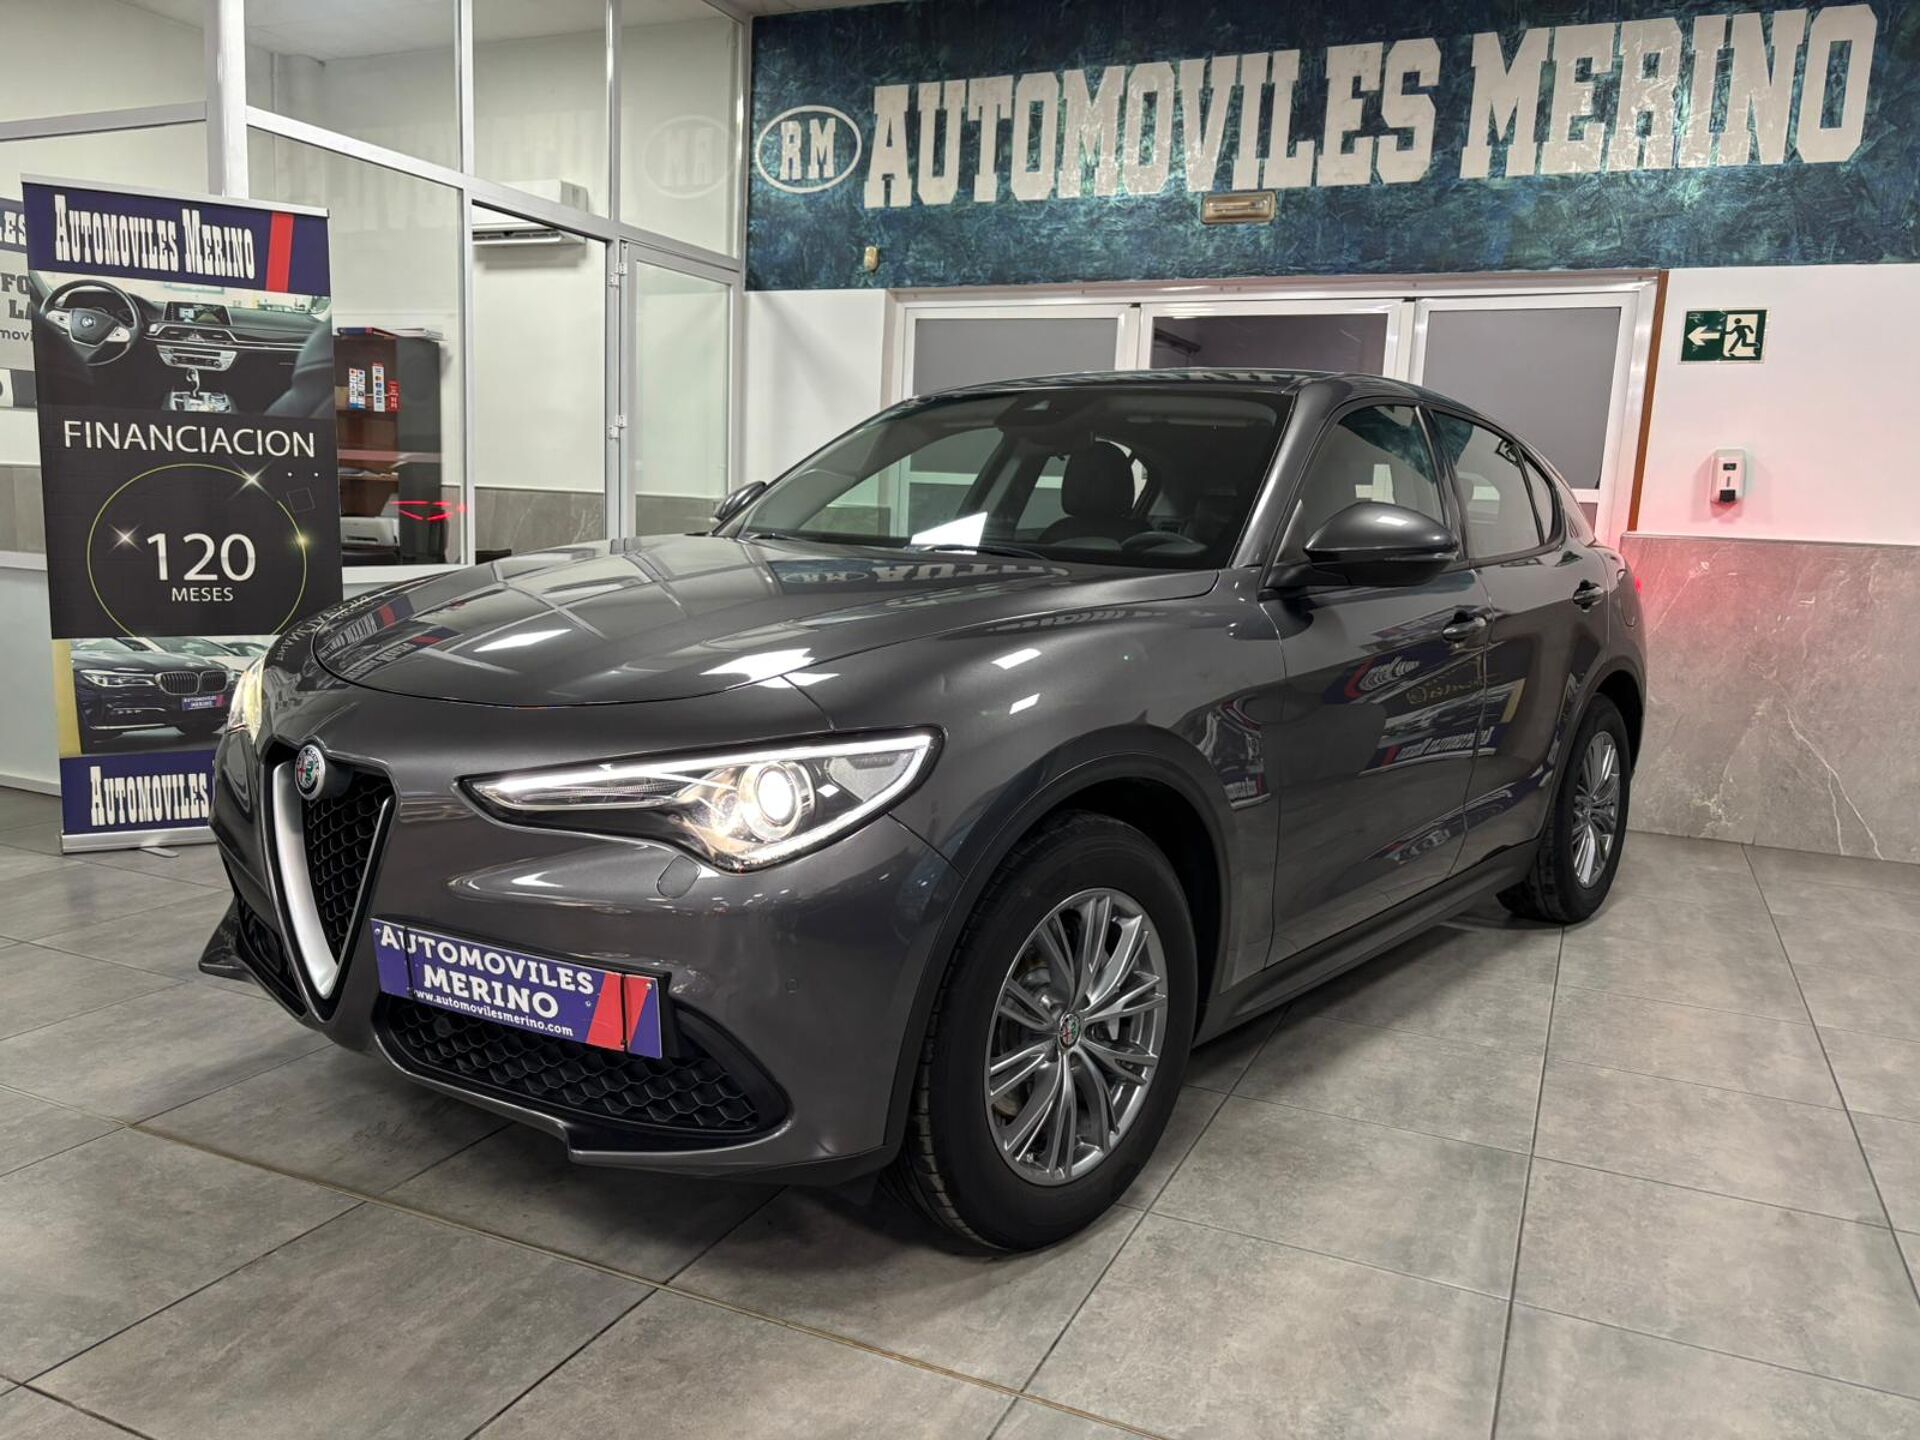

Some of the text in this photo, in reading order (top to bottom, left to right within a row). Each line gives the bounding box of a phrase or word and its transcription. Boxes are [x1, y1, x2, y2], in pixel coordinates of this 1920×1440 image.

[863, 4, 1878, 208] AUTOMOVILES MERINO
[779, 117, 836, 181] RM
[0, 211, 27, 246] ES
[54, 194, 256, 279] AUTOMOVILES MERINO
[63, 420, 315, 458] FINANCIACION
[147, 532, 256, 582] 120
[171, 586, 234, 602] MESES
[89, 765, 210, 826] AUTOMOVILES
[380, 924, 594, 995] AUTOMOVILES
[423, 963, 559, 1019] MERINO
